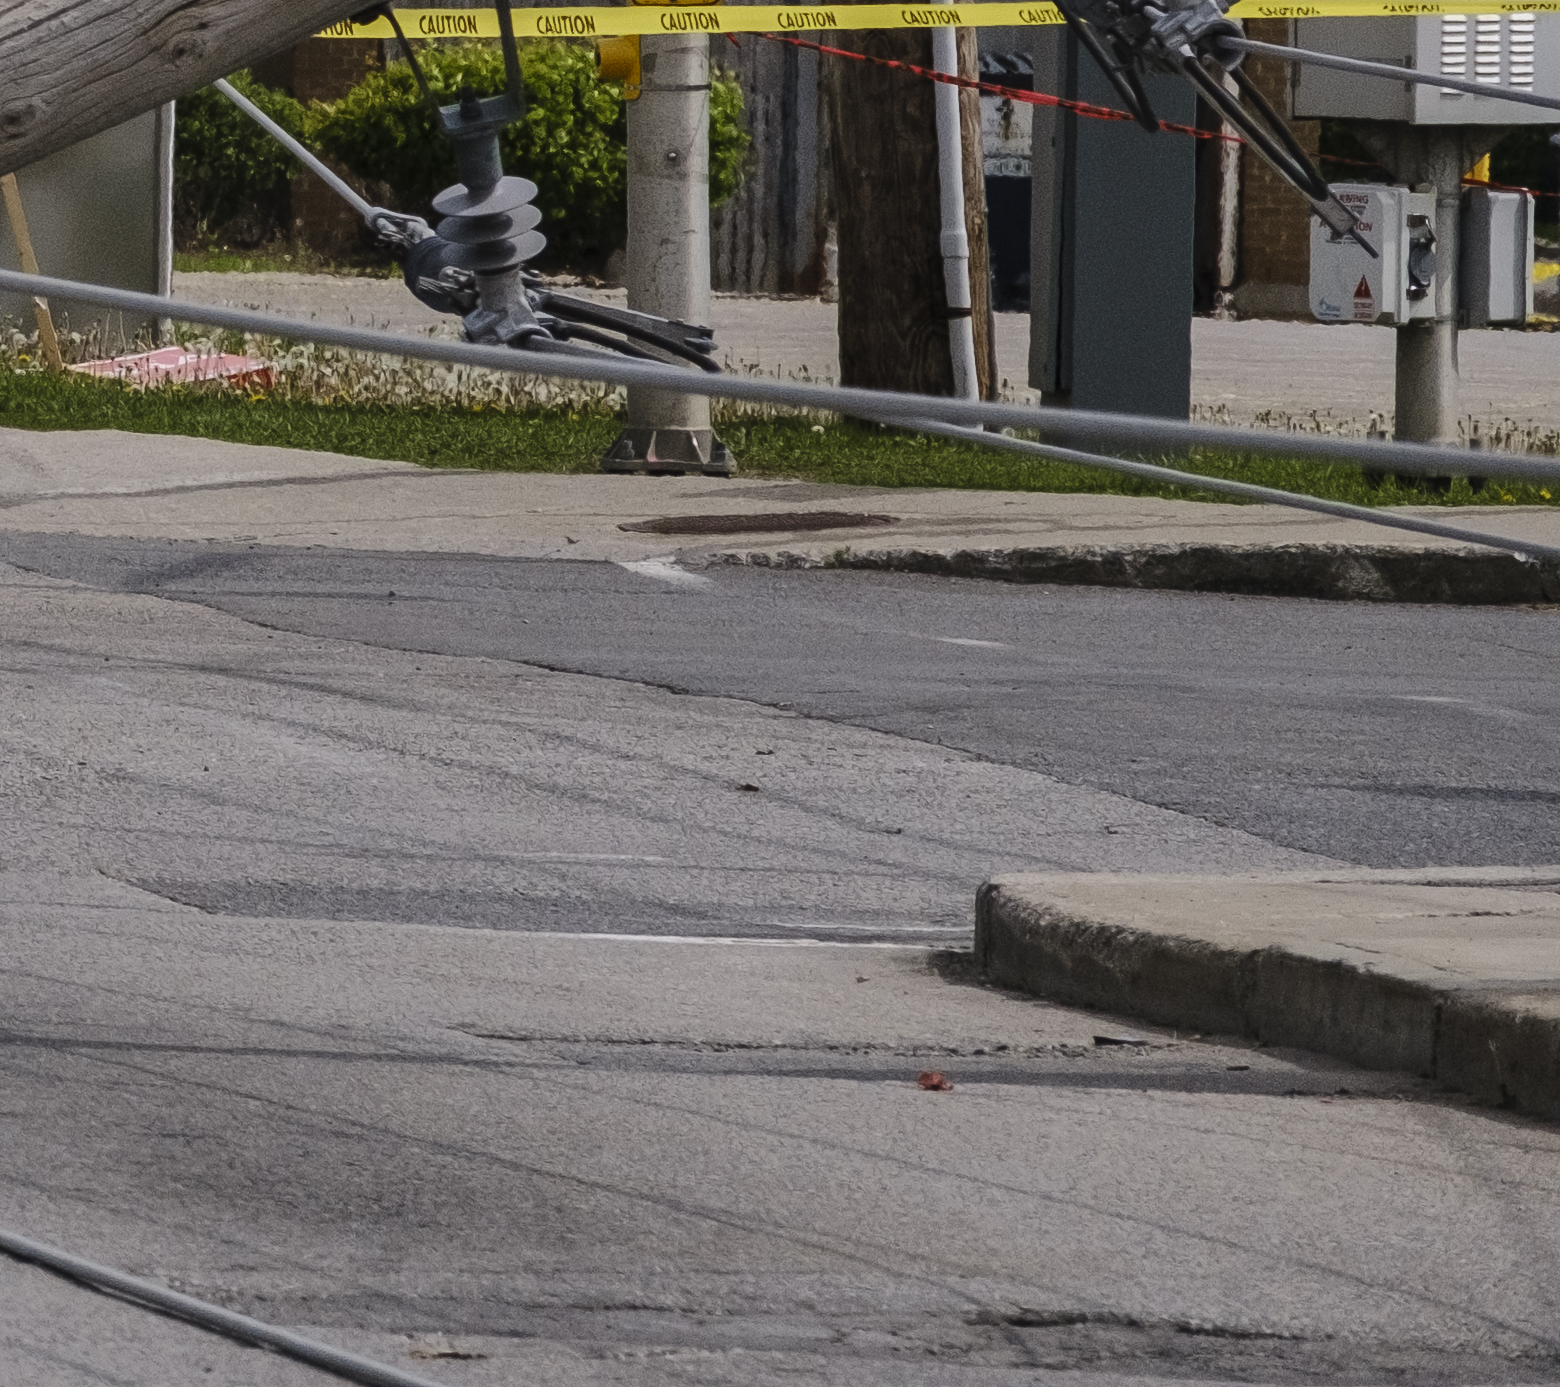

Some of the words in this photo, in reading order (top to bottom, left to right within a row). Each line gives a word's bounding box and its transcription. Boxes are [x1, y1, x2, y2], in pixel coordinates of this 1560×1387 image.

[419, 14, 479, 35] CAUTION
[536, 14, 597, 35] CAUTION
[660, 11, 721, 31] CAUTION
[777, 11, 837, 29] CAUTION
[901, 10, 962, 26] CAUTION
[1018, 9, 1066, 25] CAUTIO
